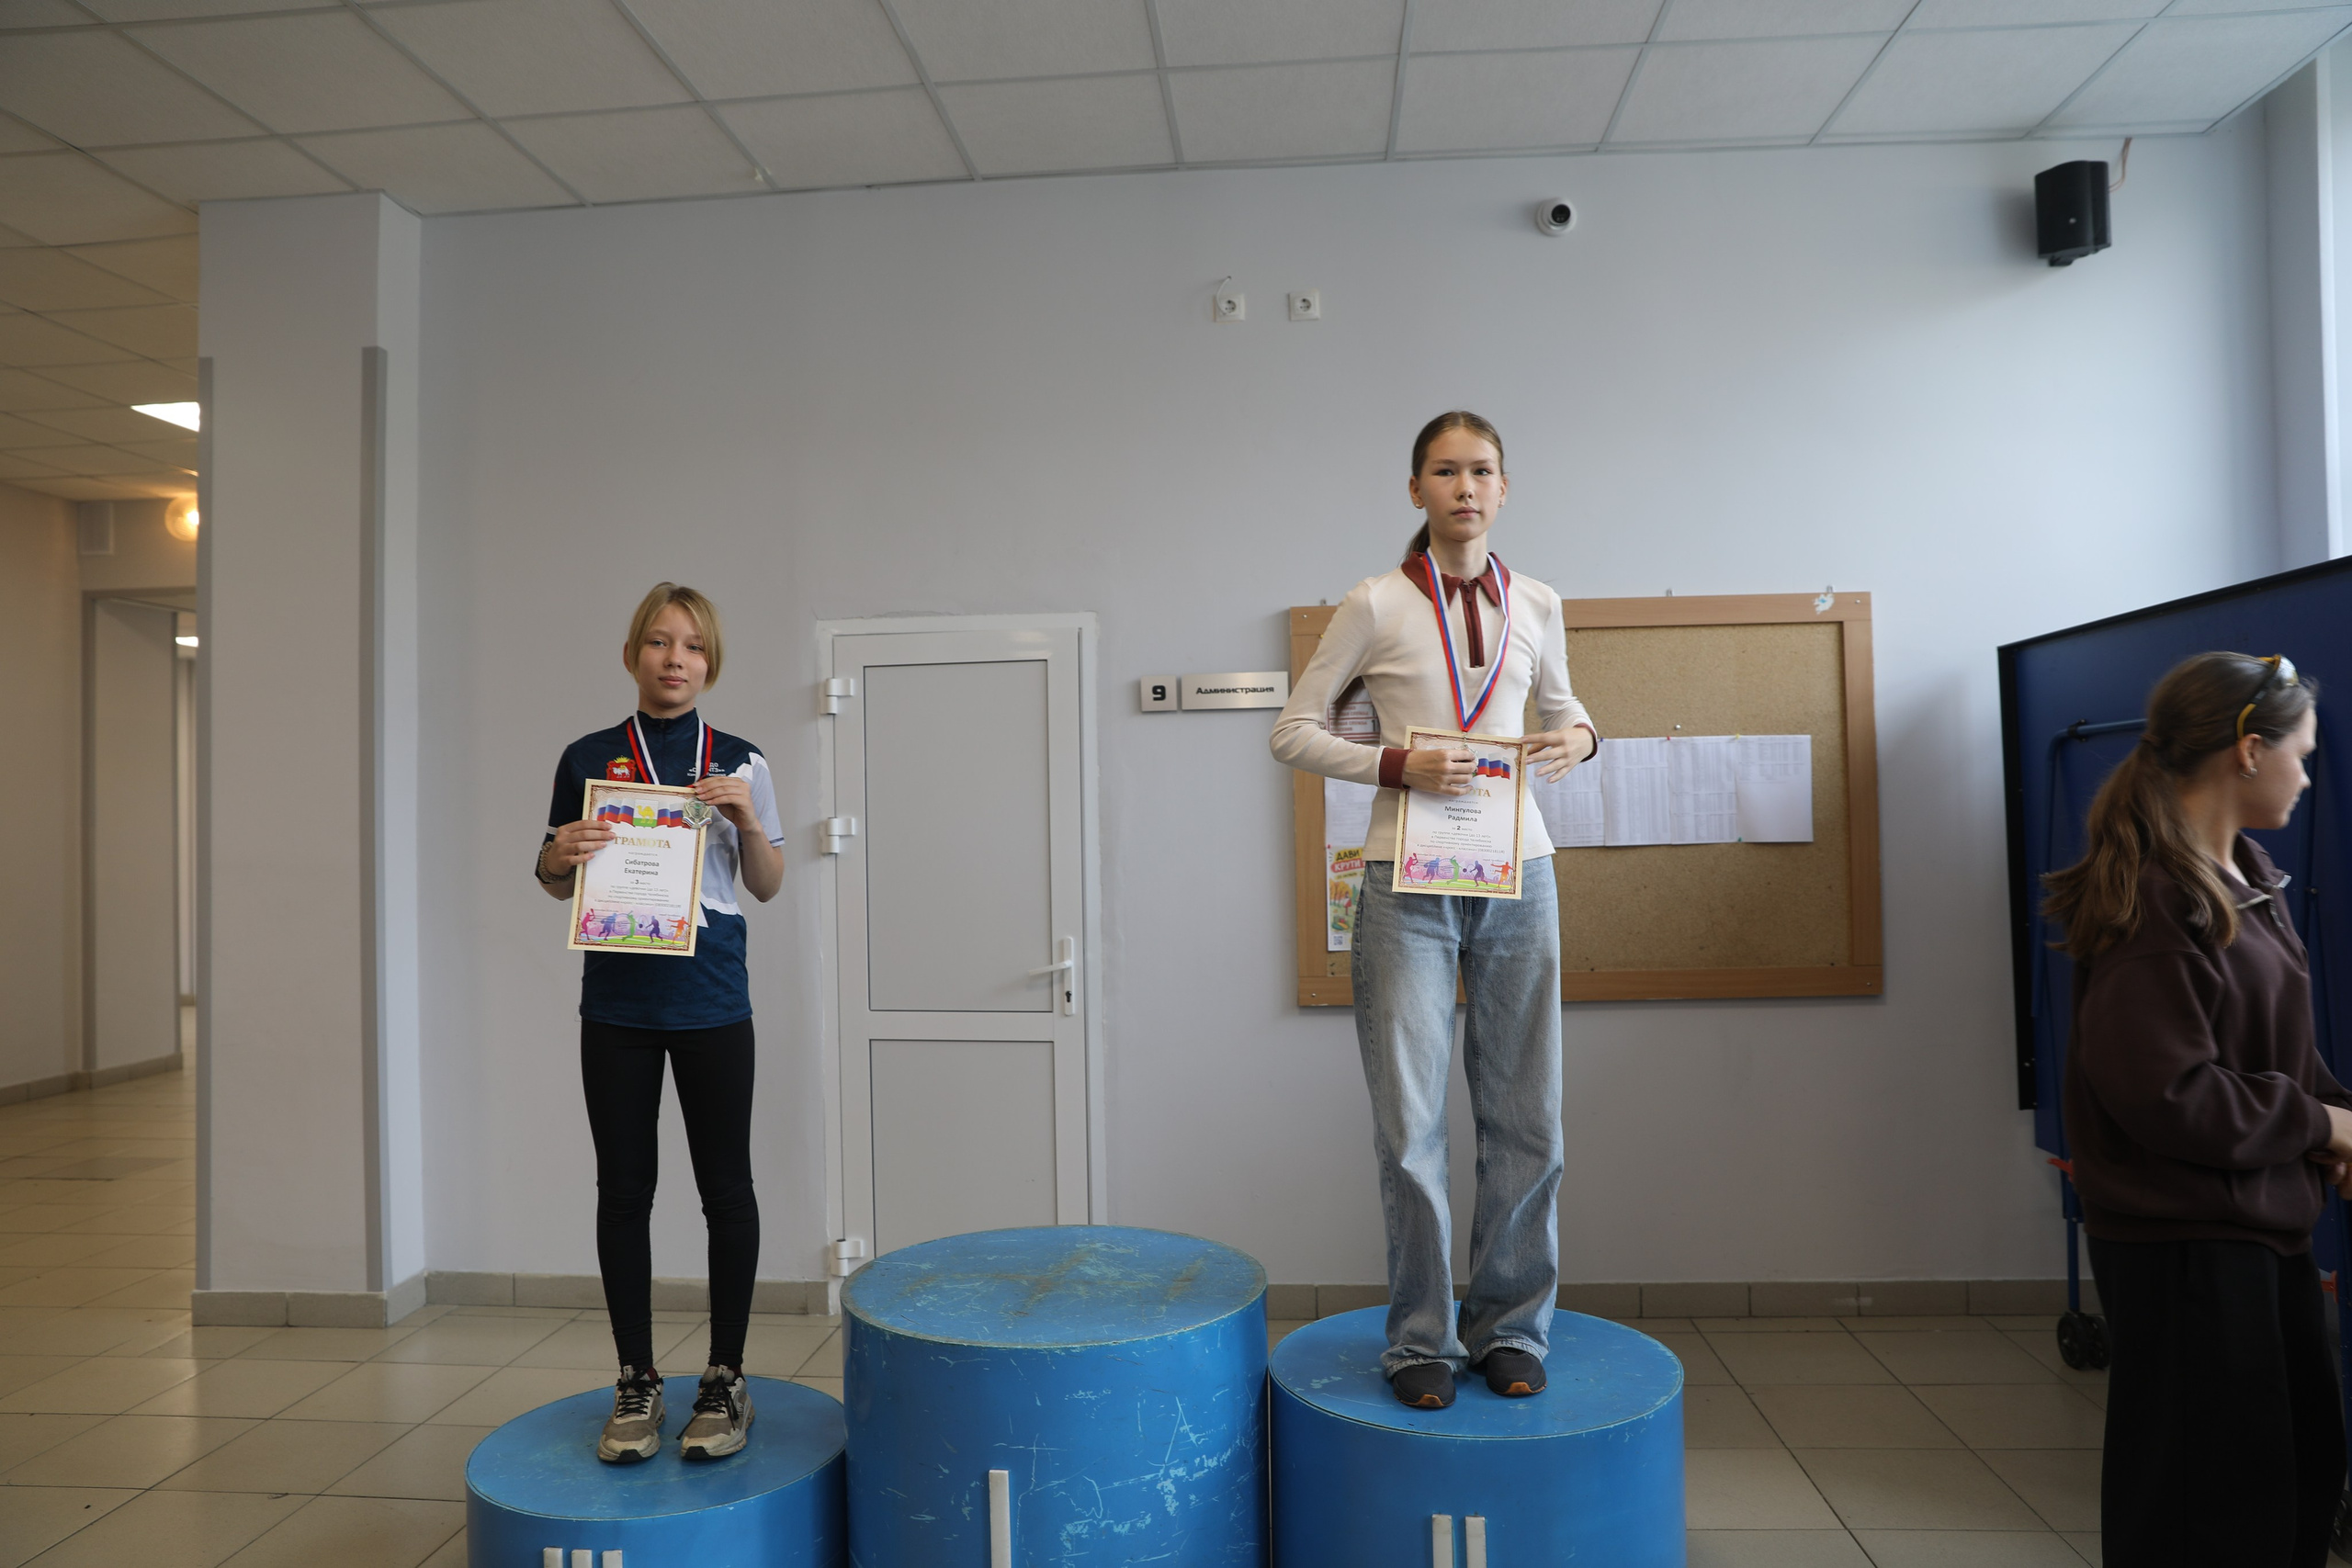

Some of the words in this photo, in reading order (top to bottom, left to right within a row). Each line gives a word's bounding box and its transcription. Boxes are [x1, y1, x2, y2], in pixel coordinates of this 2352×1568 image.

[1151, 684, 1166, 701] 9
[1195, 686, 1274, 694] Администрация
[1444, 807, 1482, 815] Мингулова
[614, 836, 671, 849] ГРАМОТА
[625, 859, 660, 867] Сибатрова
